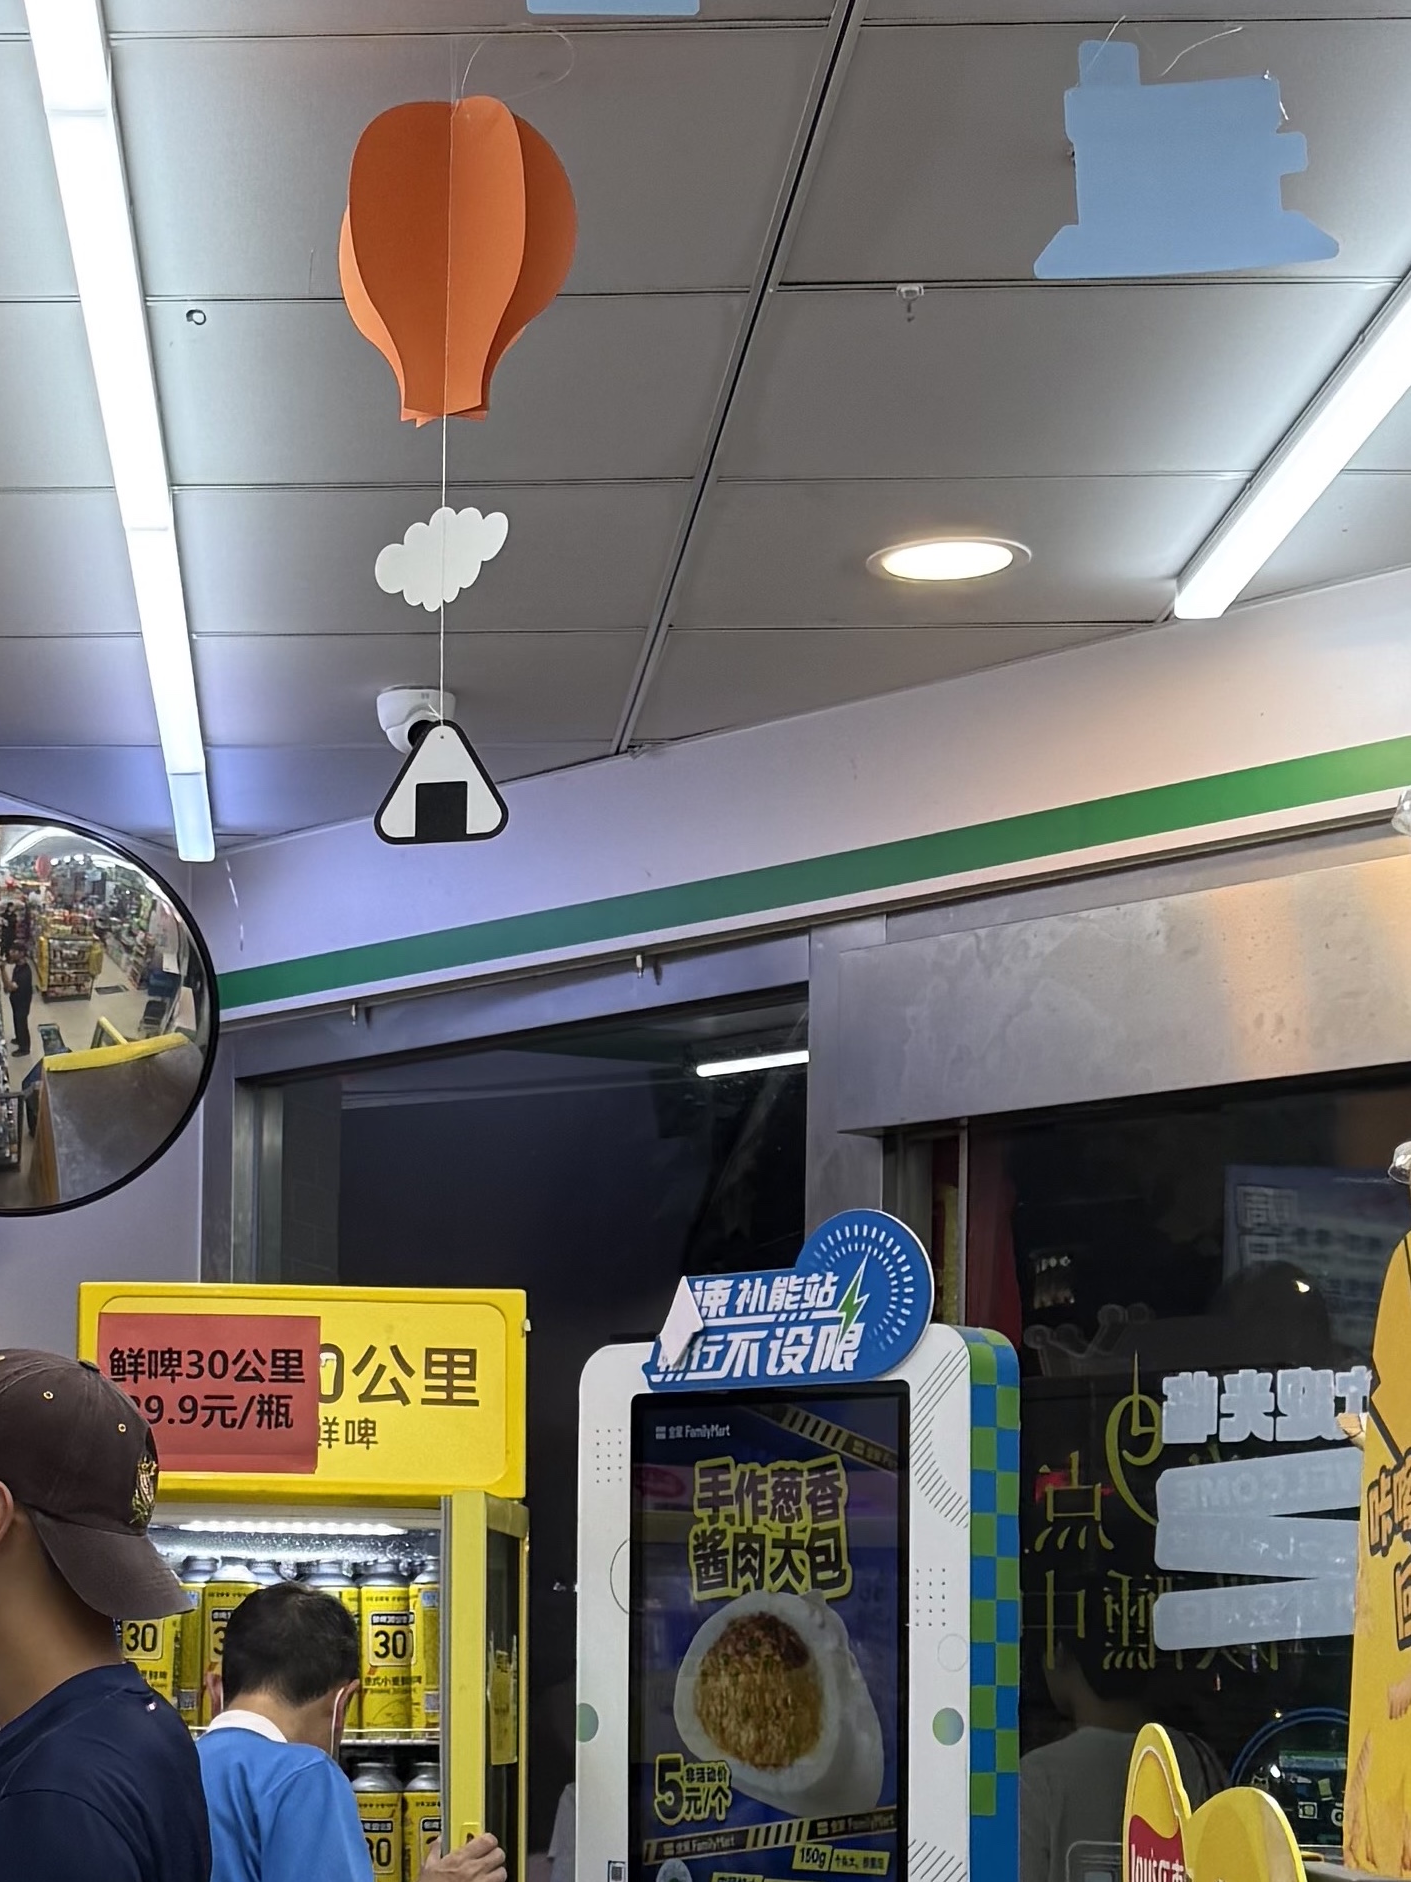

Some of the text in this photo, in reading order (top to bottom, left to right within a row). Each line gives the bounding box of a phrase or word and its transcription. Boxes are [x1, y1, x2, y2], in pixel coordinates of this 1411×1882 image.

[109, 1347, 306, 1384] 鲜啤30公里
[694, 1456, 846, 1525] 手作葱香
[692, 1526, 850, 1598] 酱肉大包
[126, 1623, 158, 1652] 30
[374, 1630, 407, 1659] 30
[685, 1786, 731, 1820] 元/个
